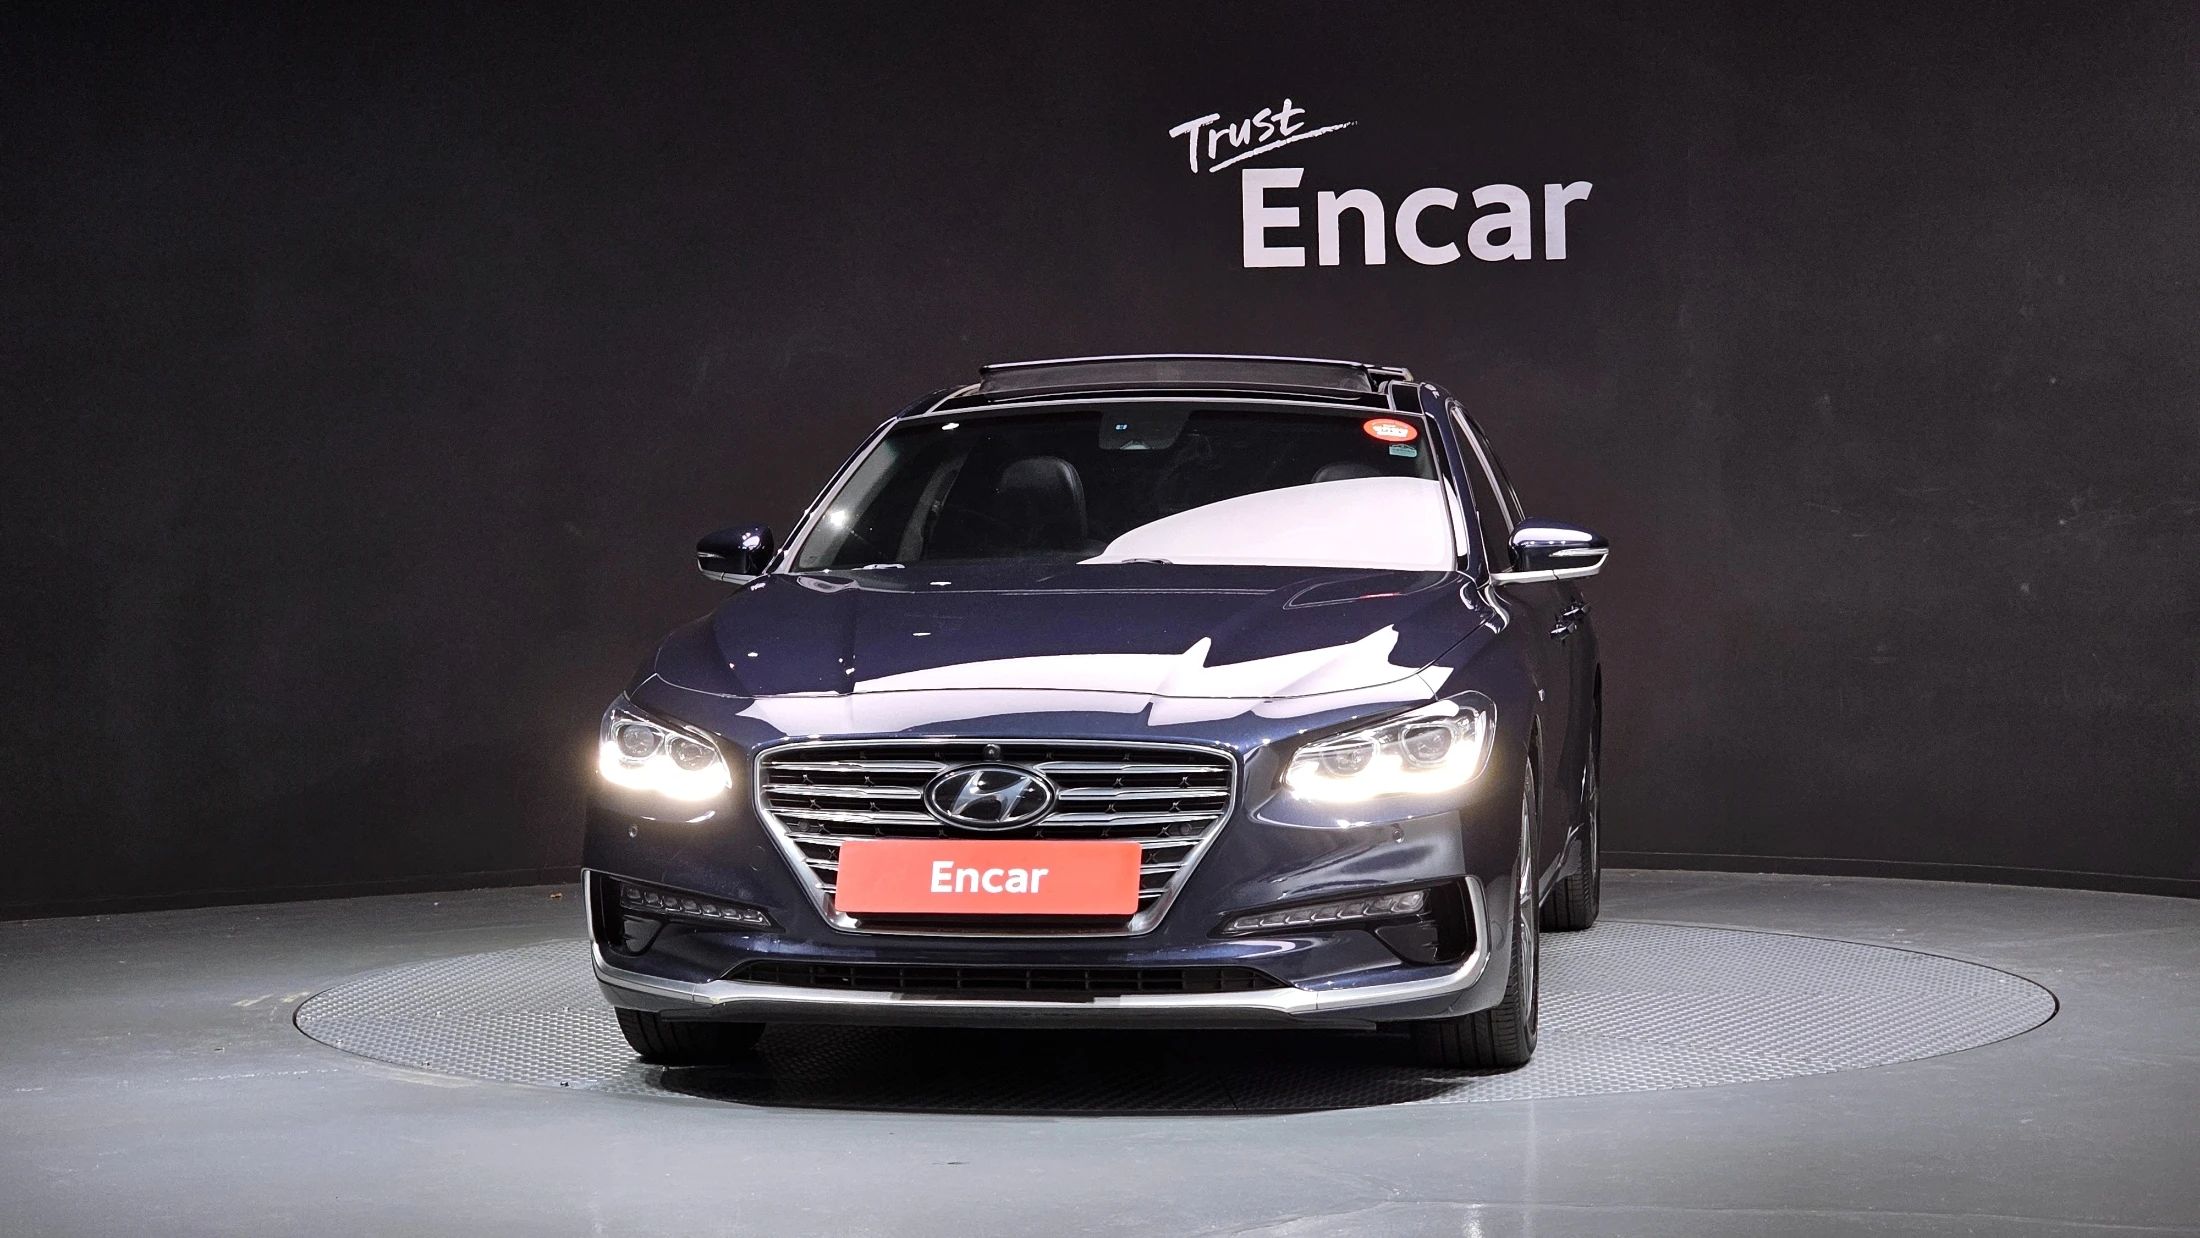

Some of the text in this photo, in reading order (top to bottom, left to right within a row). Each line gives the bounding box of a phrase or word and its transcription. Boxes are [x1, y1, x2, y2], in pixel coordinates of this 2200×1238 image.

[1169, 98, 1305, 173] Trust
[1242, 167, 1593, 267] Encar
[930, 860, 1049, 893] Encar
